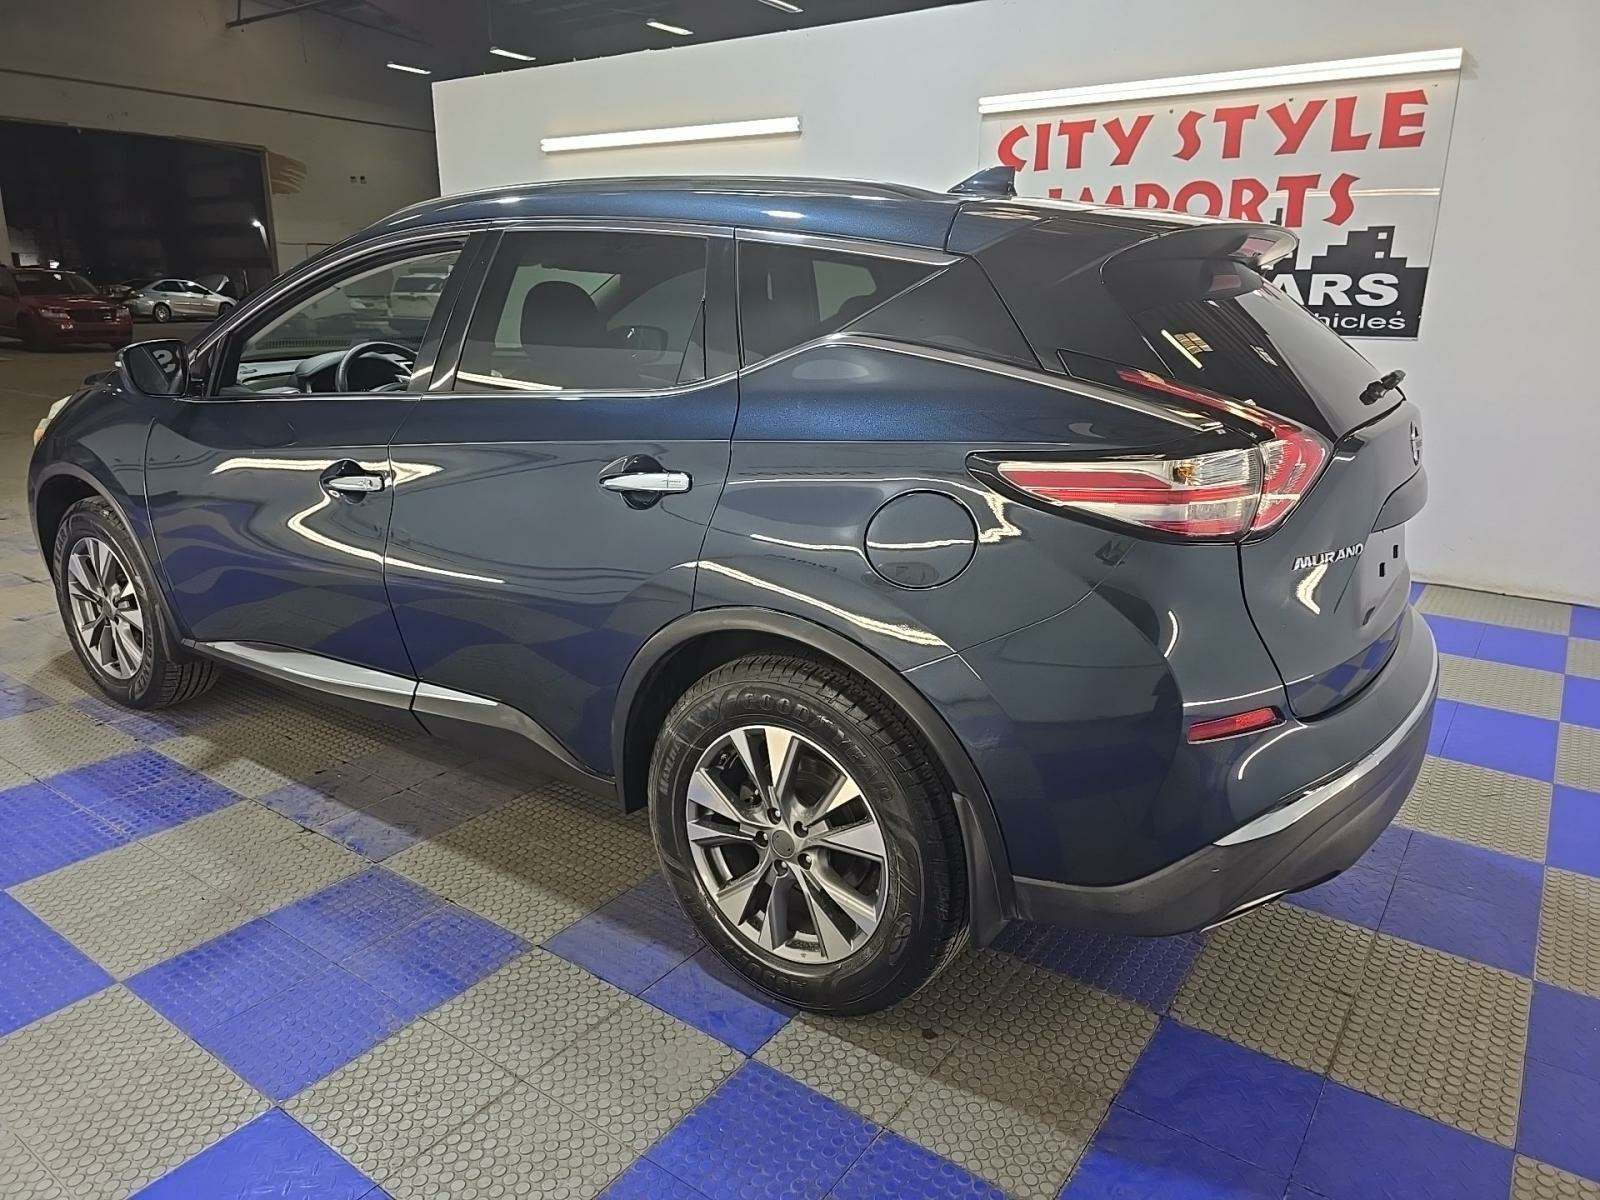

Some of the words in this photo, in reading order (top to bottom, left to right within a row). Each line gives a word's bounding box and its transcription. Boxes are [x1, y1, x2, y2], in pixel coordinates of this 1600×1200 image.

[997, 115, 1154, 171] CITY
[1174, 90, 1428, 160] STYLE
[1049, 173, 1360, 228] PORTS
[1271, 272, 1400, 307] ARS
[1292, 543, 1364, 571] MURANO
